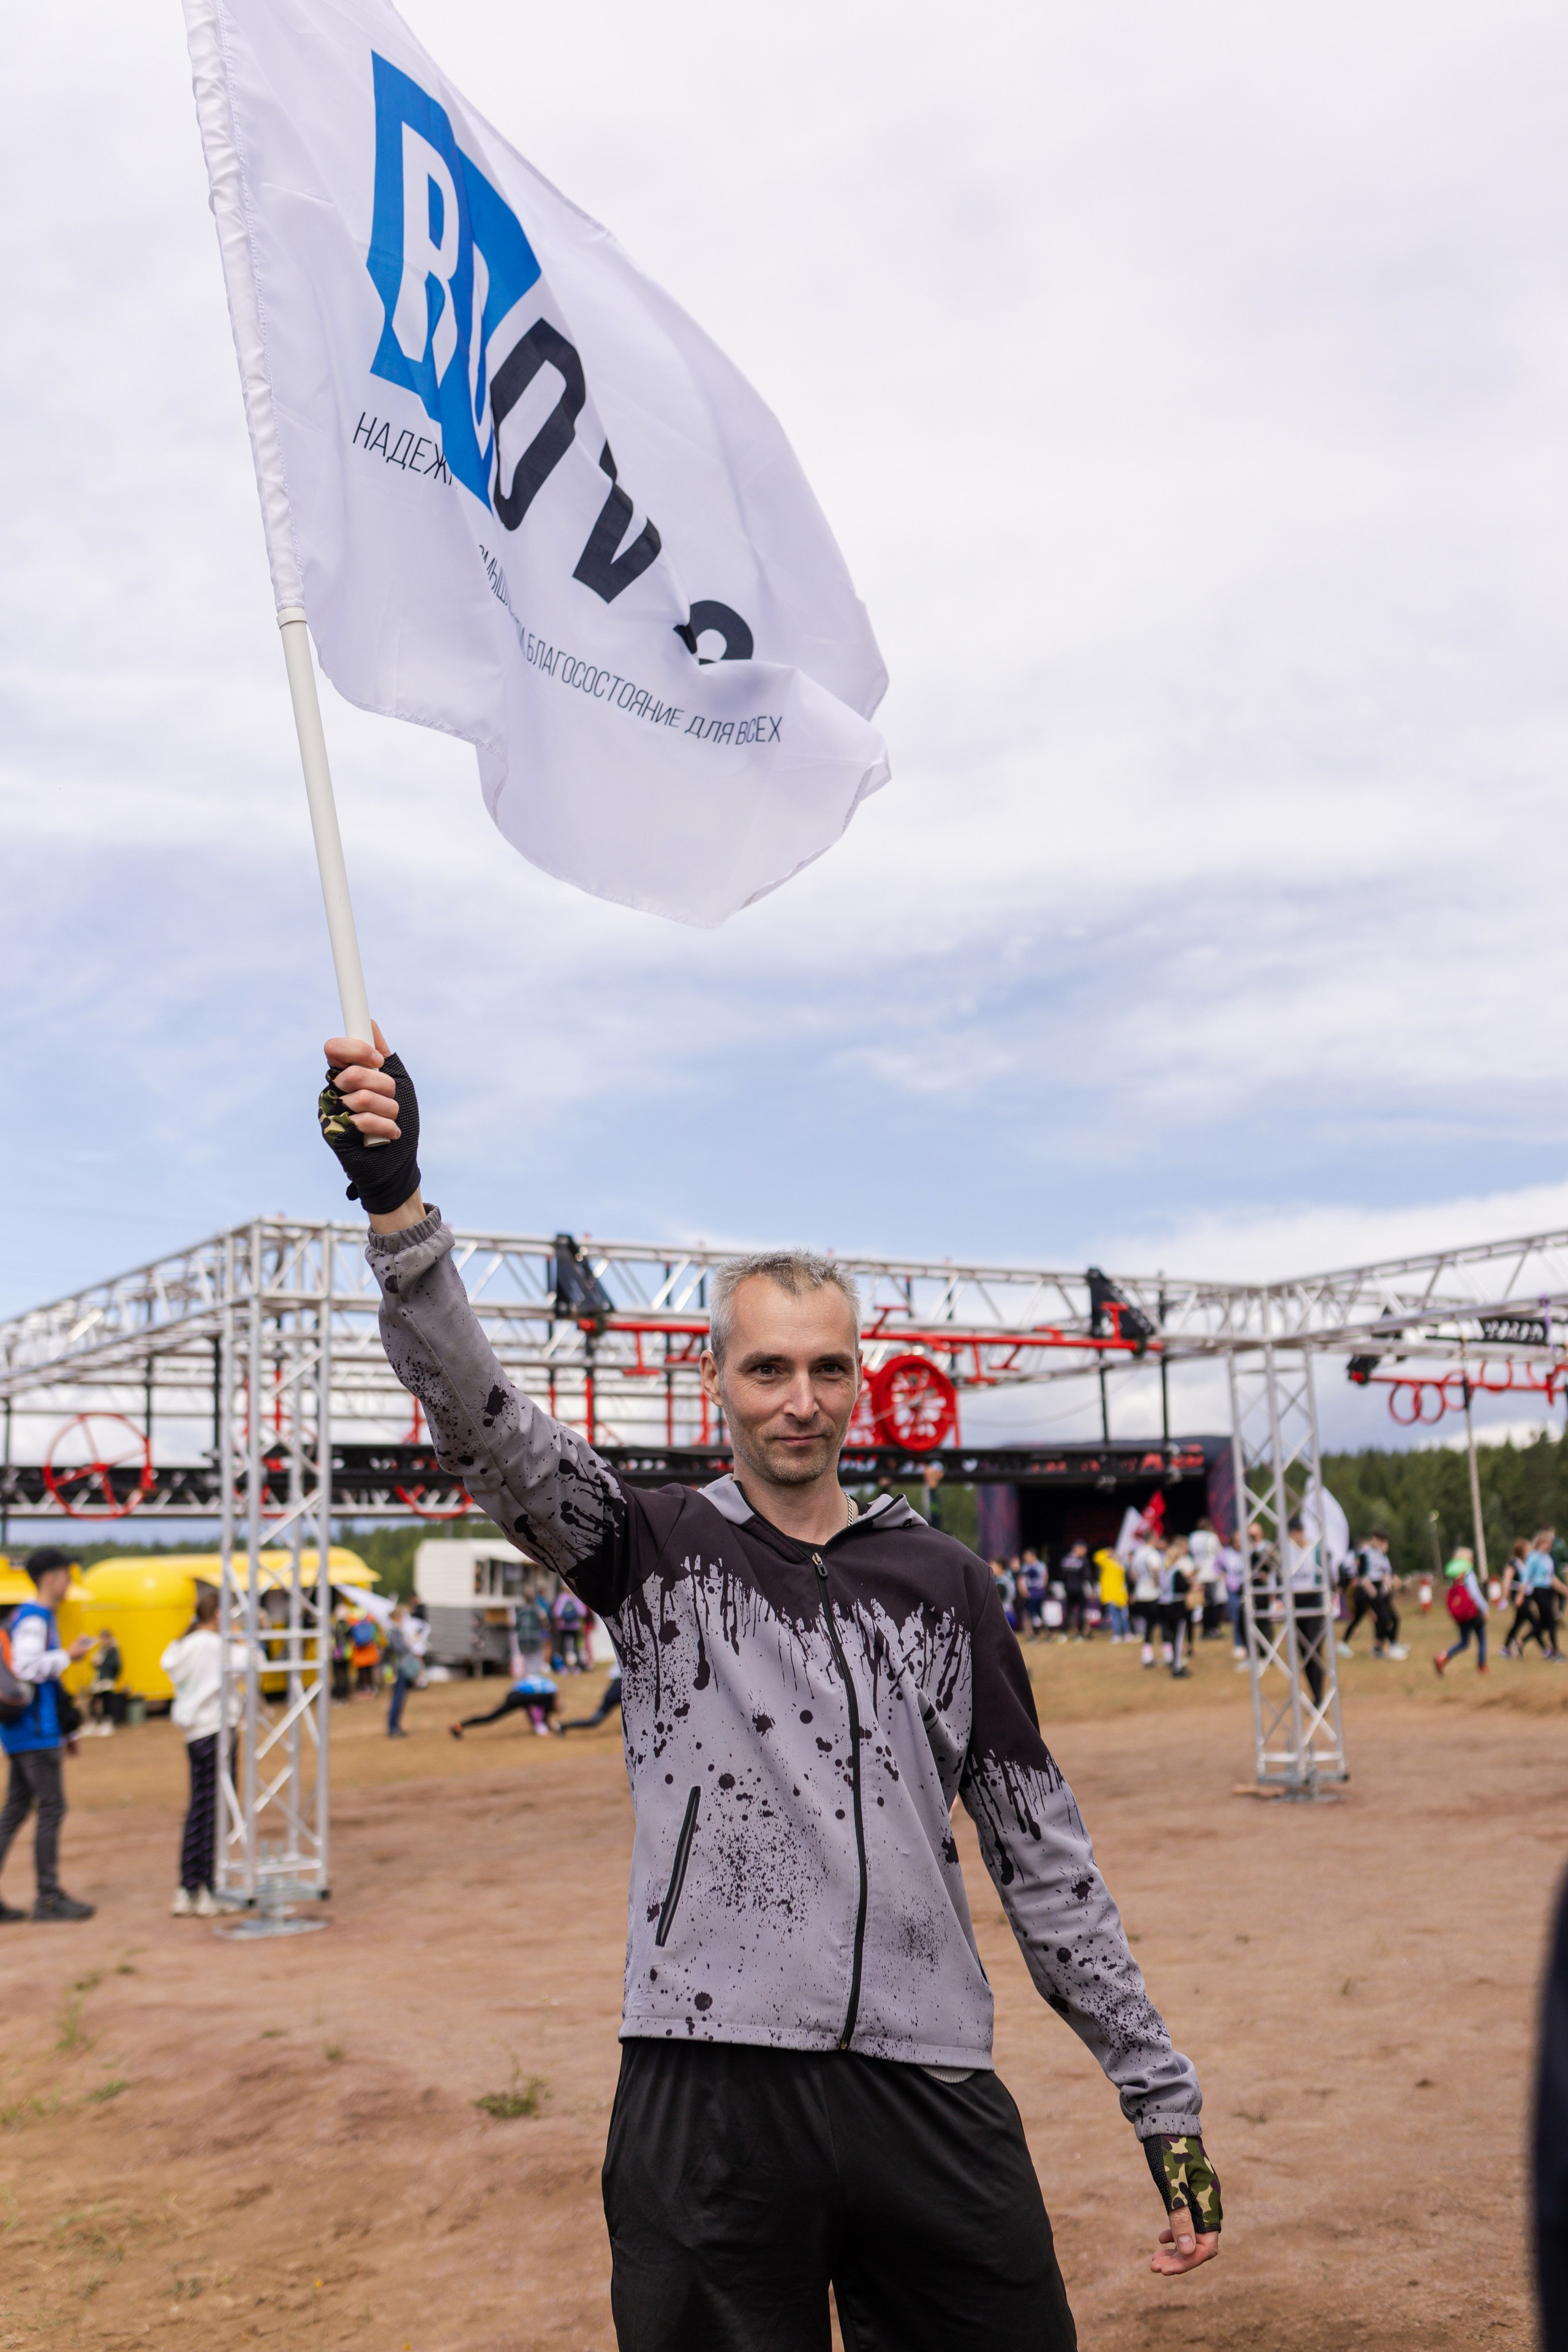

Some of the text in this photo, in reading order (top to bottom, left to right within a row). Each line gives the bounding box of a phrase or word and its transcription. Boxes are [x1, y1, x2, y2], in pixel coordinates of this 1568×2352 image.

[352, 411, 783, 745] НАДЕЖ БЛАГОСОСТОЯНИЕ ДЛЯ ВСЕХ
